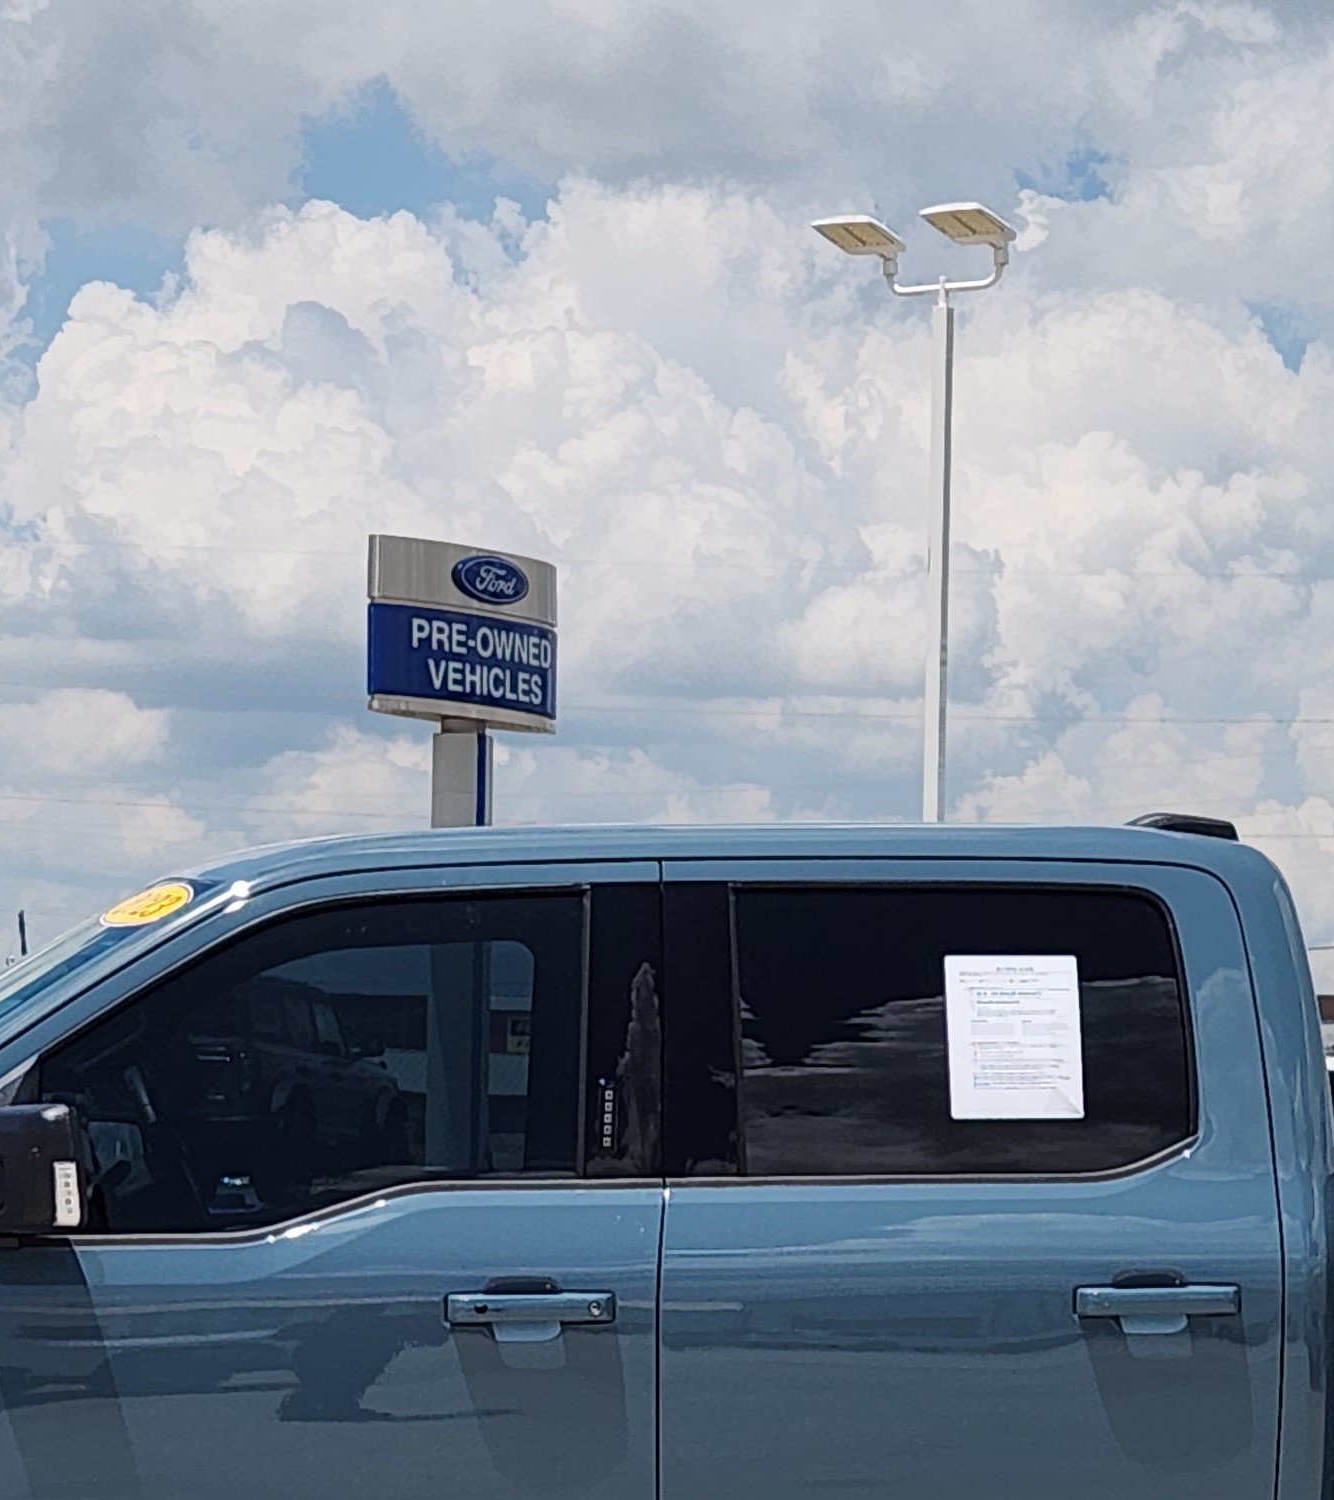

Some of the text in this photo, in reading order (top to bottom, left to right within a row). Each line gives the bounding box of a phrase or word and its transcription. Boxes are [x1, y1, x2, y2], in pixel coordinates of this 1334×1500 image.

[475, 565, 516, 595] Ford
[411, 617, 552, 669] PRE-OWNED
[427, 658, 543, 705] VEHICLES
